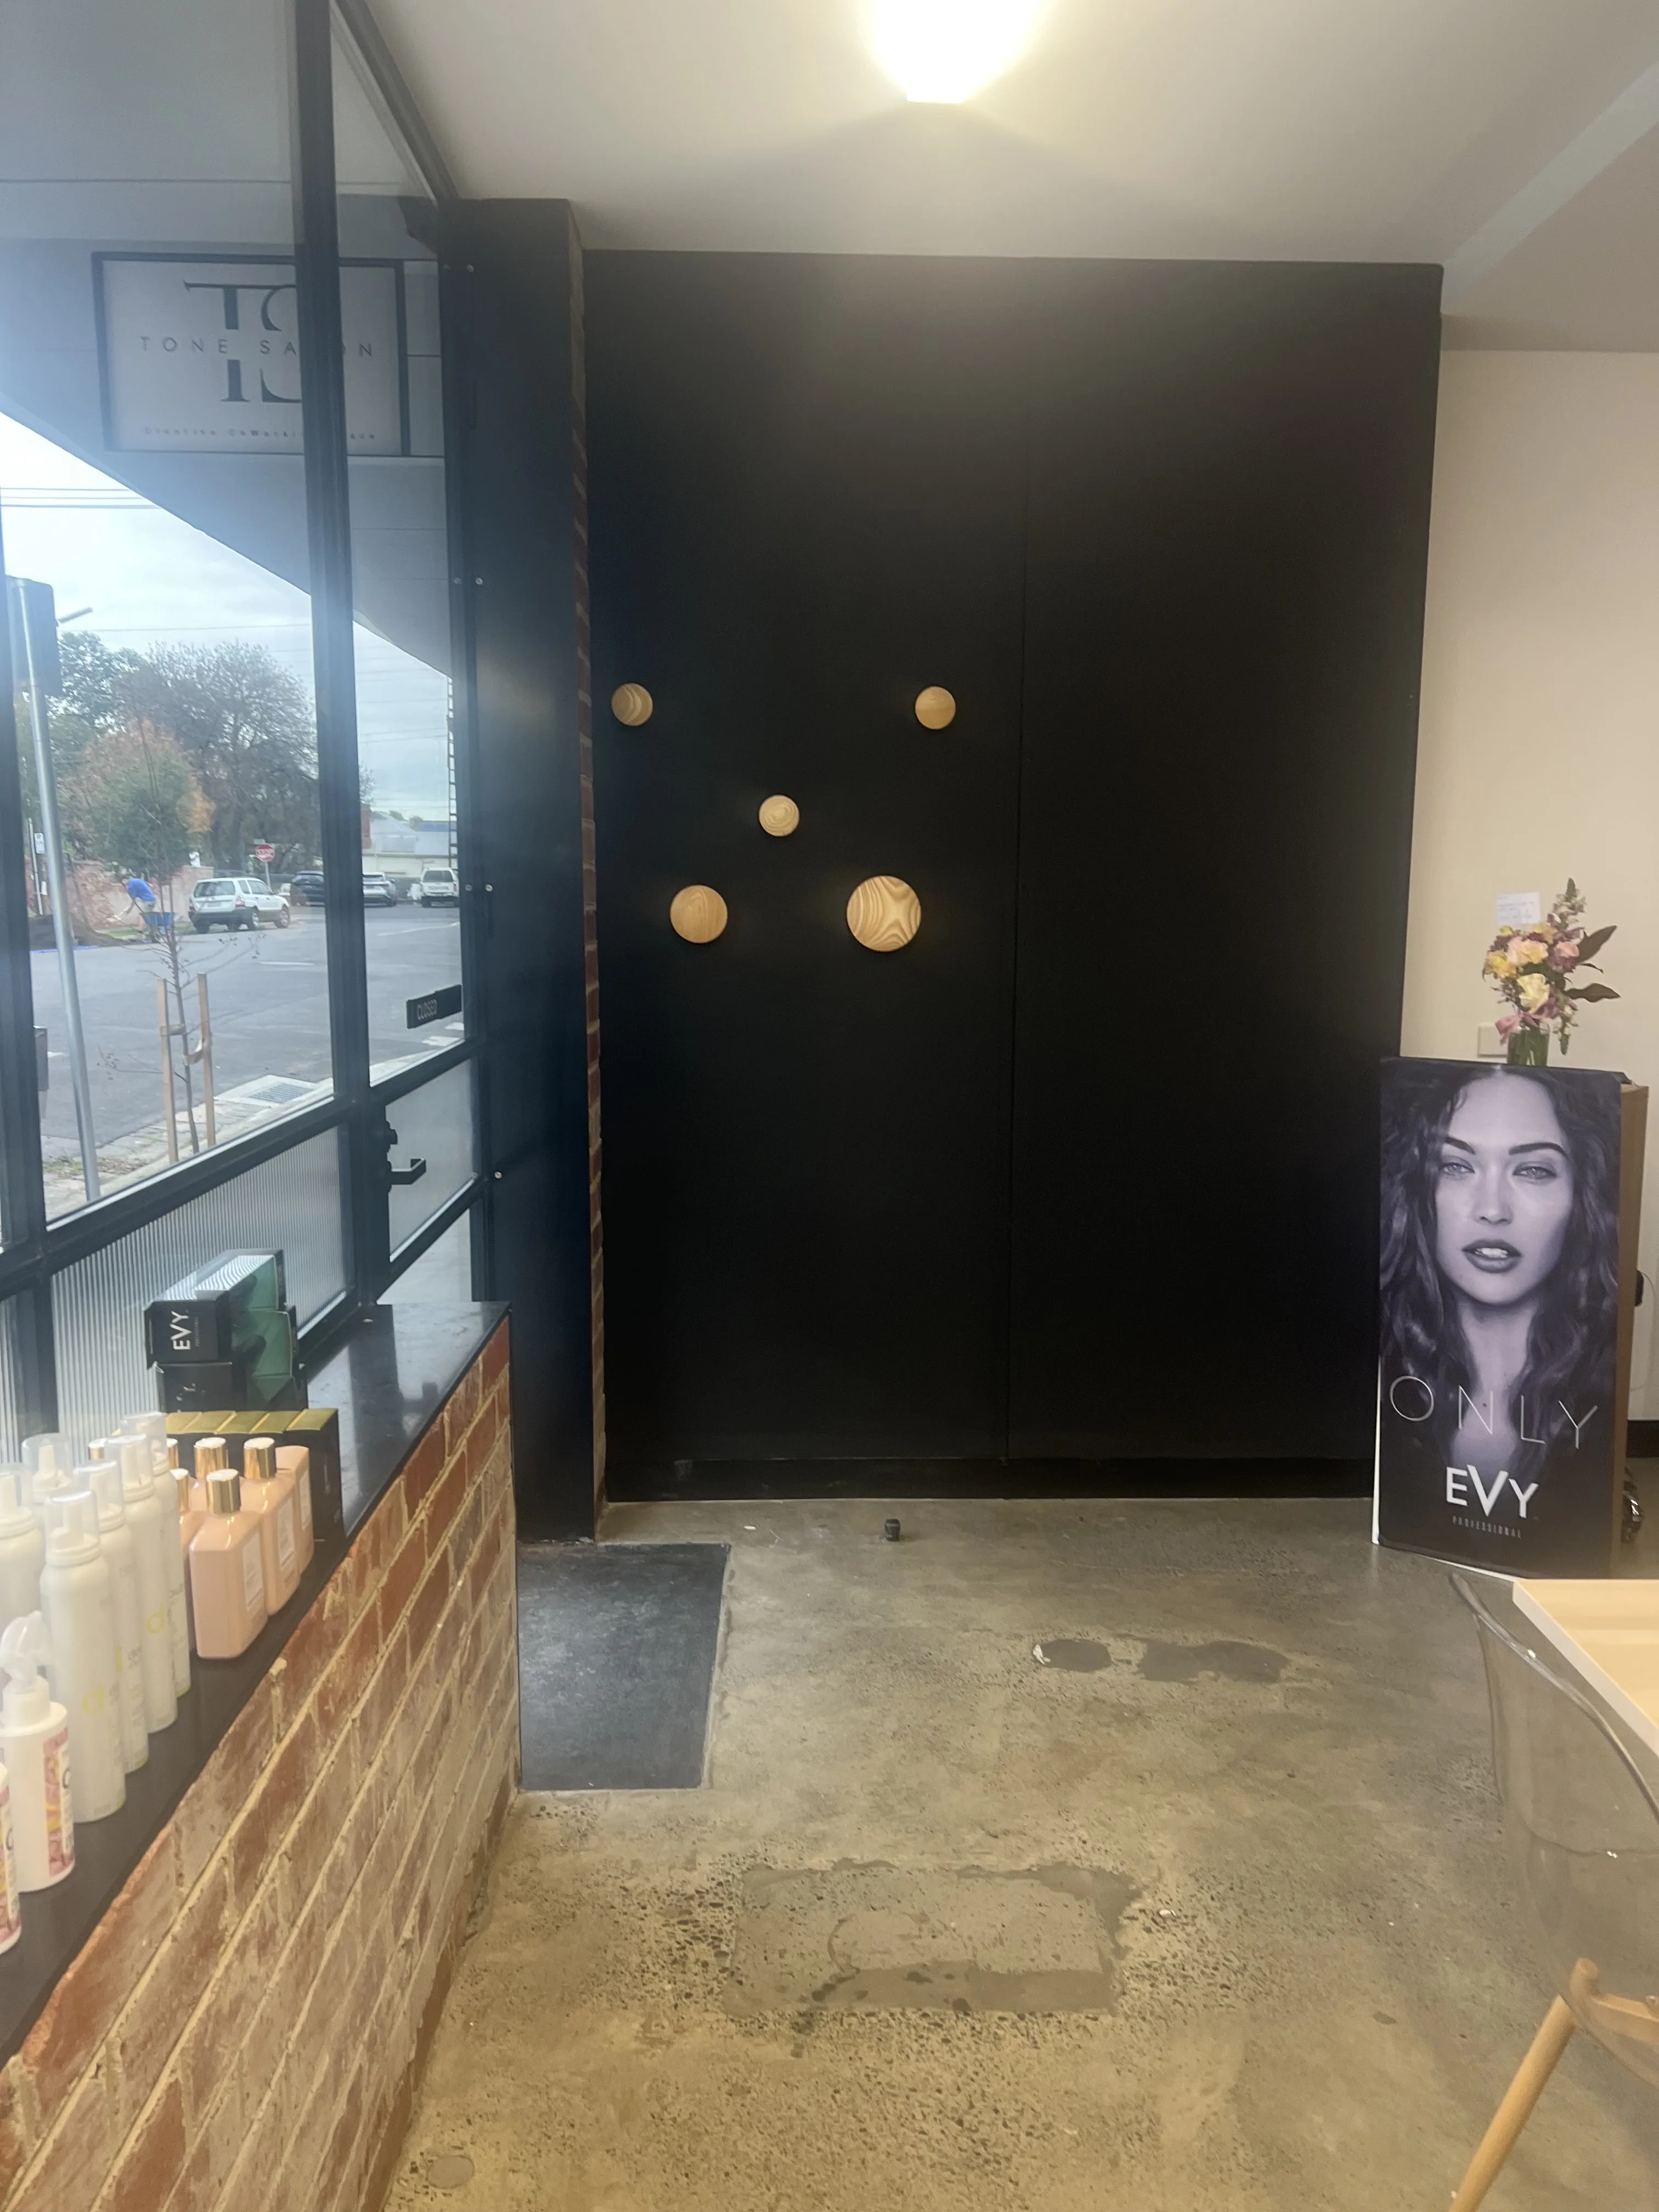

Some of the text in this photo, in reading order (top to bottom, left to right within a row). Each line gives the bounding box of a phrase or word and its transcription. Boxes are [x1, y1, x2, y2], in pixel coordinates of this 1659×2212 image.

[140, 336, 373, 357] TONE SAN
[417, 998, 437, 1020] CLOSED
[170, 1311, 192, 1350] EVY
[1389, 1376, 1599, 1449] ONLY
[1446, 1464, 1539, 1519] EVY
[1452, 1516, 1521, 1539] PROFESSIONAL
